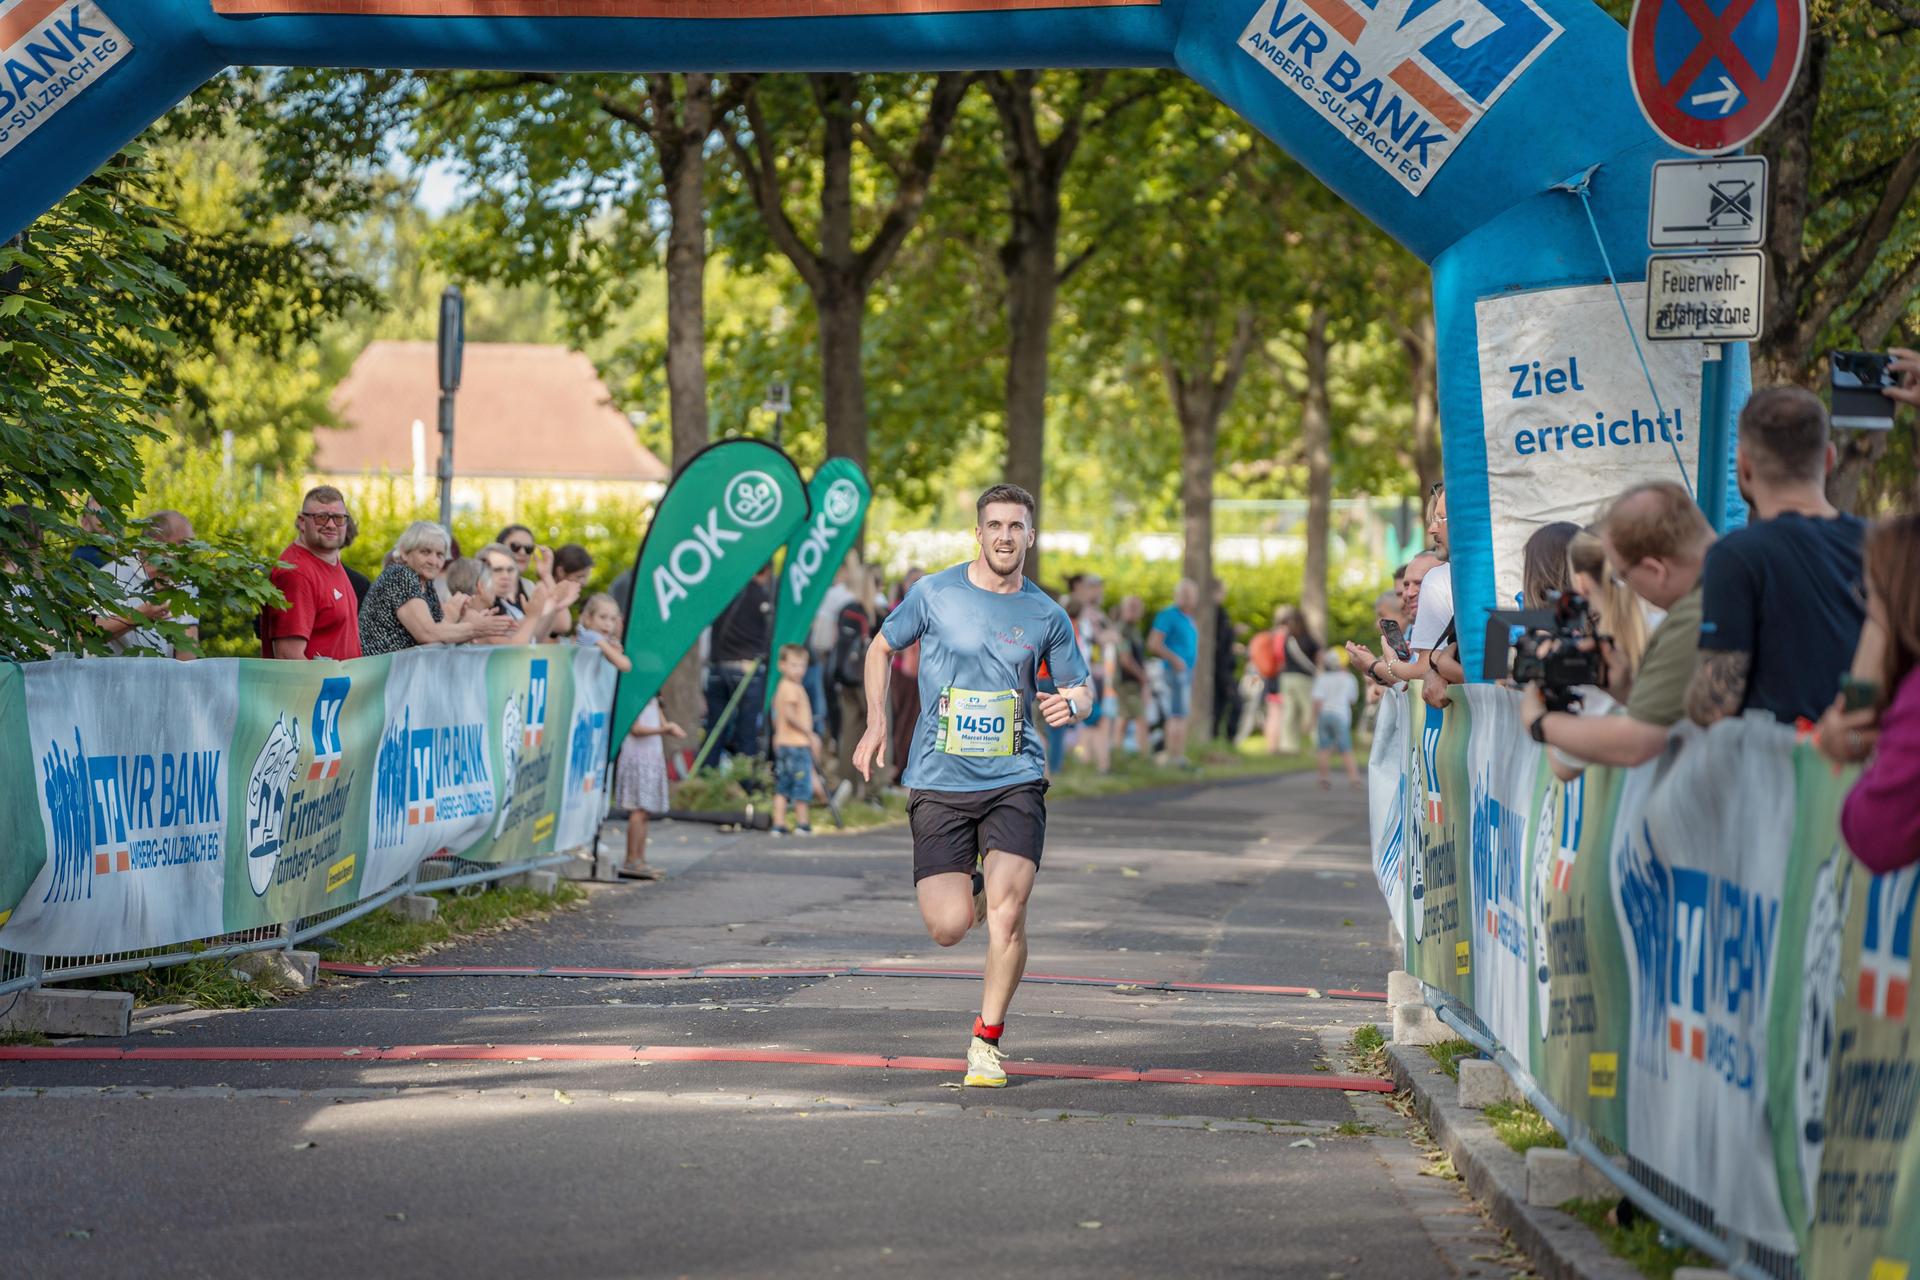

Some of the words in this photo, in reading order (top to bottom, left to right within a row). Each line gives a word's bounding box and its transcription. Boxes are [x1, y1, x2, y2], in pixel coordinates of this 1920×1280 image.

[93, 38, 118, 62] EG
[1248, 31, 1400, 165] AMBERG-SULZBACH
[1397, 157, 1421, 183] EG
[1267, 0, 1329, 69] VR
[1322, 50, 1449, 168] BANK
[1662, 267, 1746, 293] Feuerwehr-
[1509, 356, 1584, 399] Ziel
[1514, 408, 1684, 455] erreicht!
[652, 506, 743, 622] AOK
[788, 512, 839, 605] AOK
[955, 714, 1006, 734] 1450
[435, 726, 451, 789] VR
[453, 723, 489, 786] BANK
[121, 753, 155, 831] VR
[160, 750, 220, 828] BANK
[207, 832, 219, 861] EG
